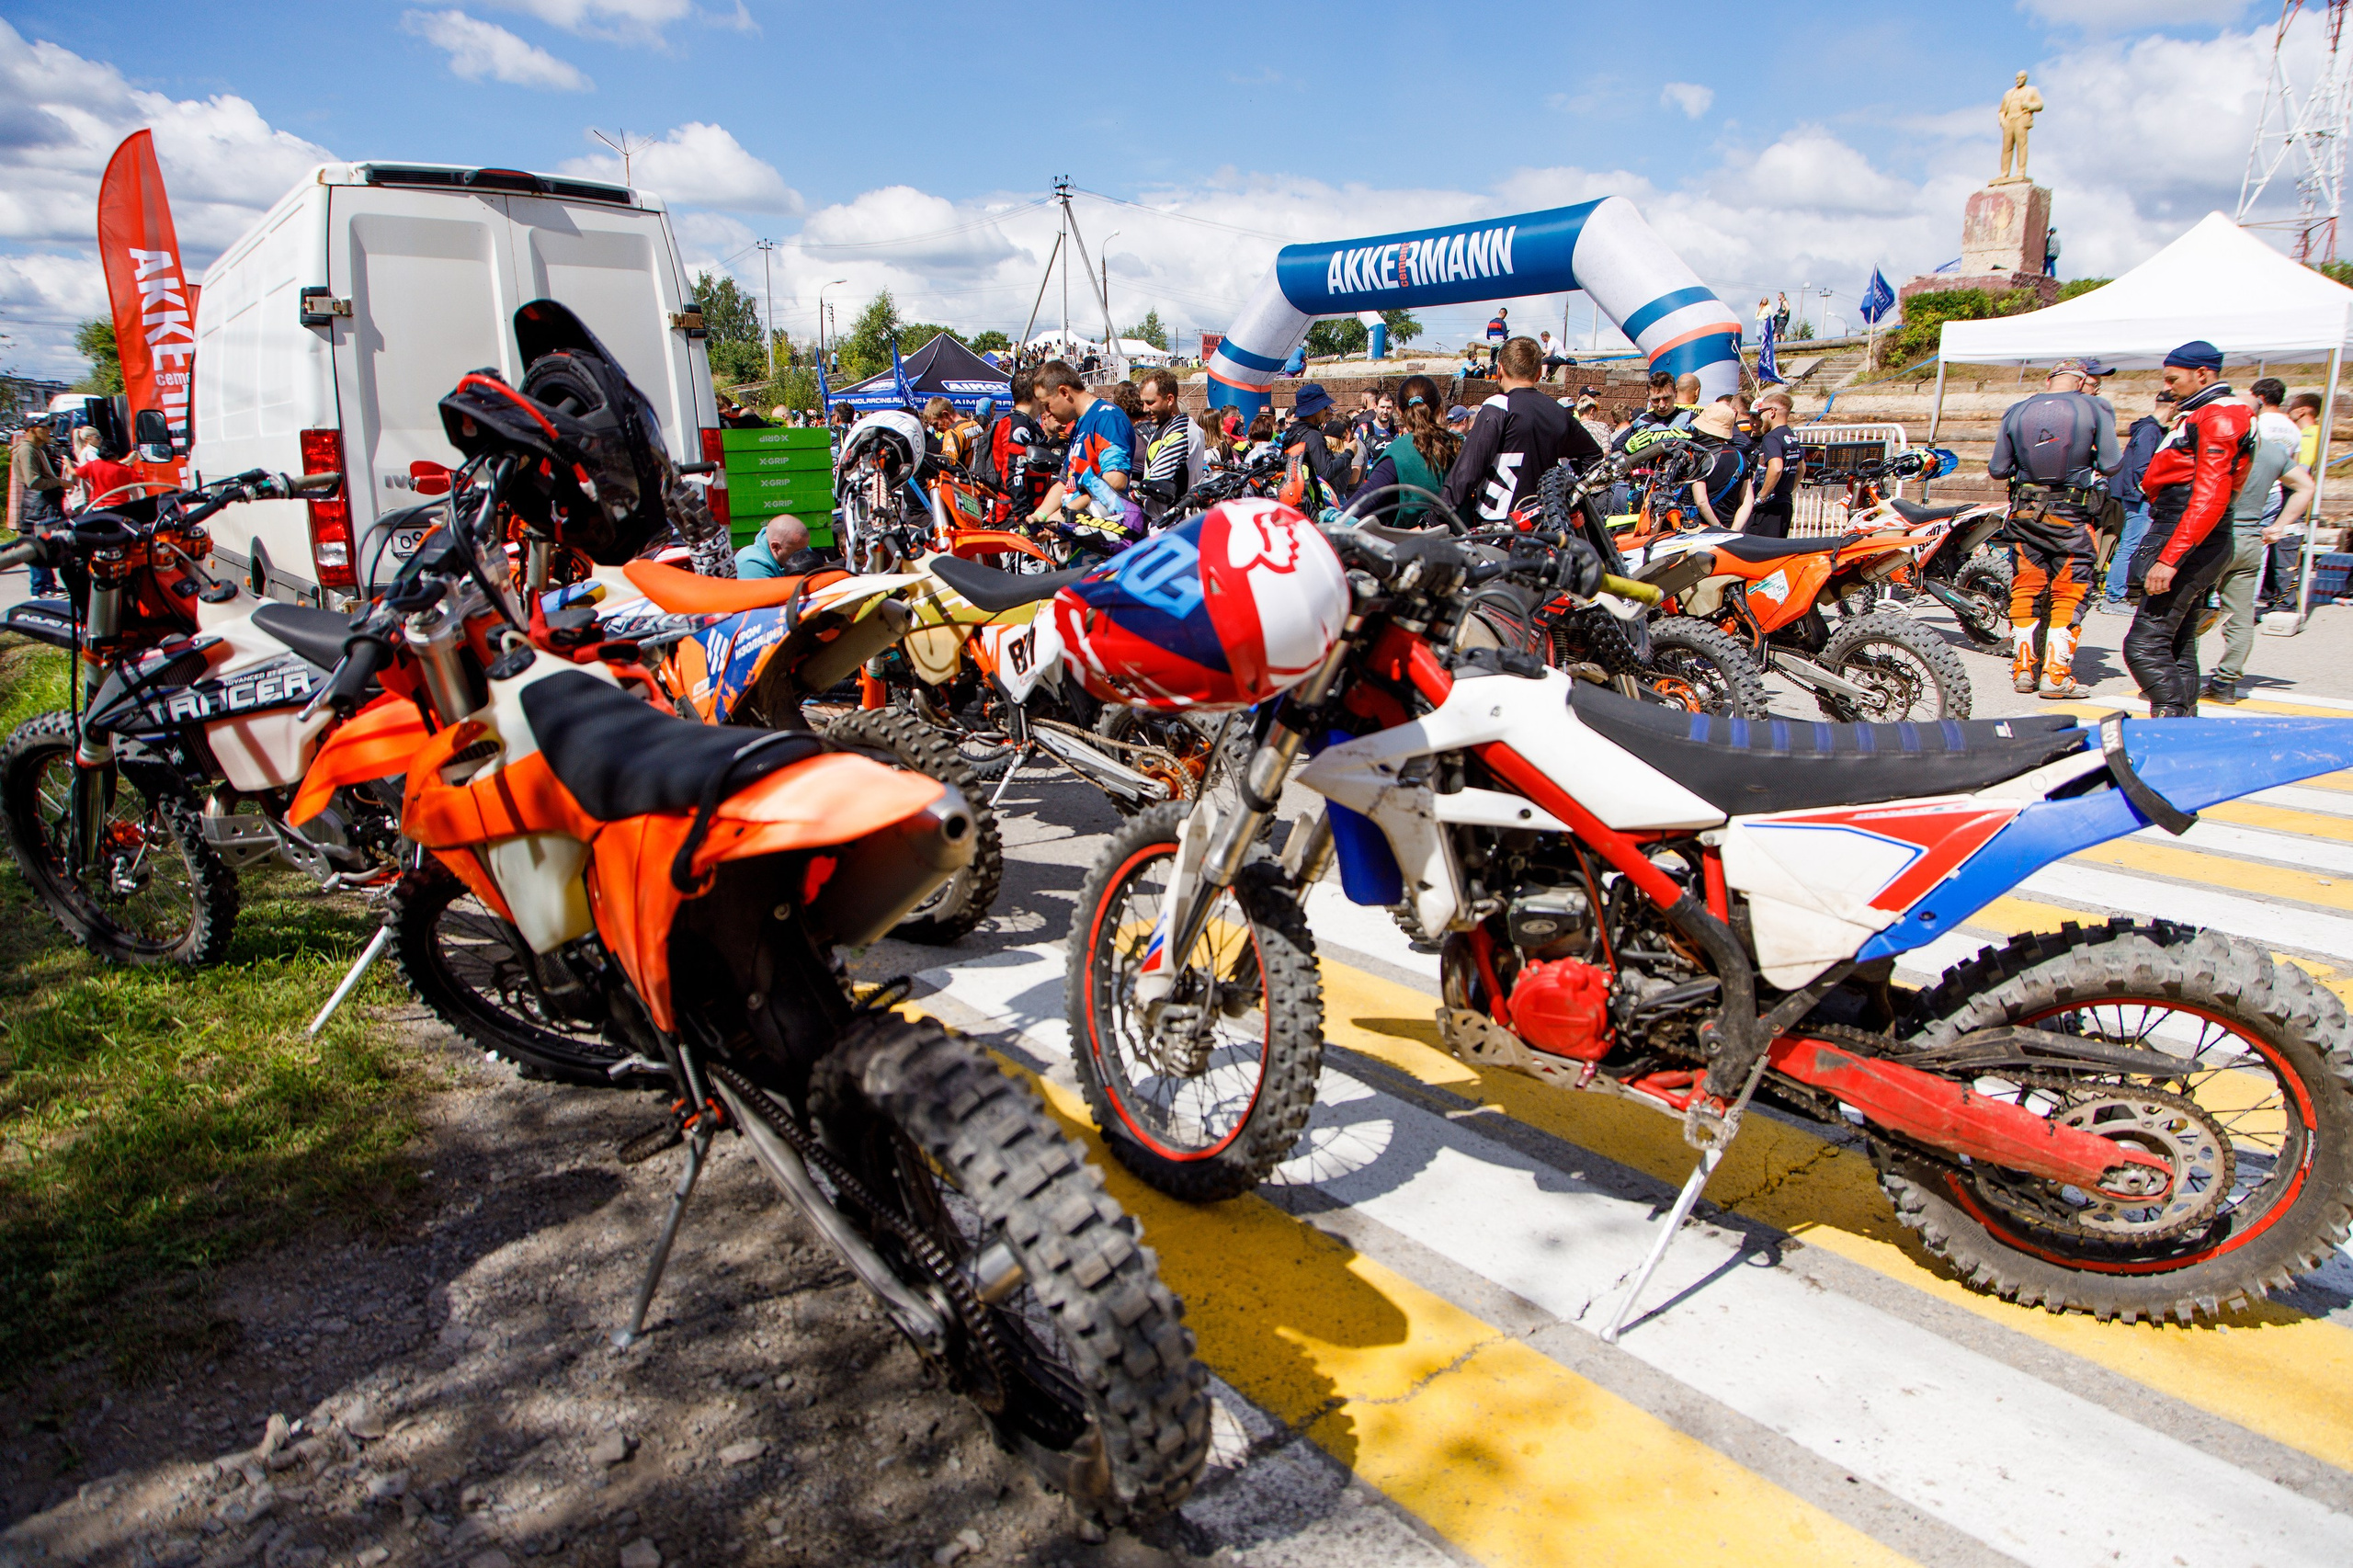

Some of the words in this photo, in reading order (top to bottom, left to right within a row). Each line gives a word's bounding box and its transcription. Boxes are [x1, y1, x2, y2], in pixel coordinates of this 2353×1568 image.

[1327, 225, 1517, 295] AKKERMANN
[1398, 241, 1410, 288] cement
[949, 382, 1009, 391] AIMOL
[828, 397, 903, 405] SHOAIMOLRACING.RU
[758, 434, 789, 442] X-GRIP
[759, 457, 789, 466] X-GRIP
[760, 478, 790, 487] X-GRIP
[764, 499, 793, 508] X-GRIP
